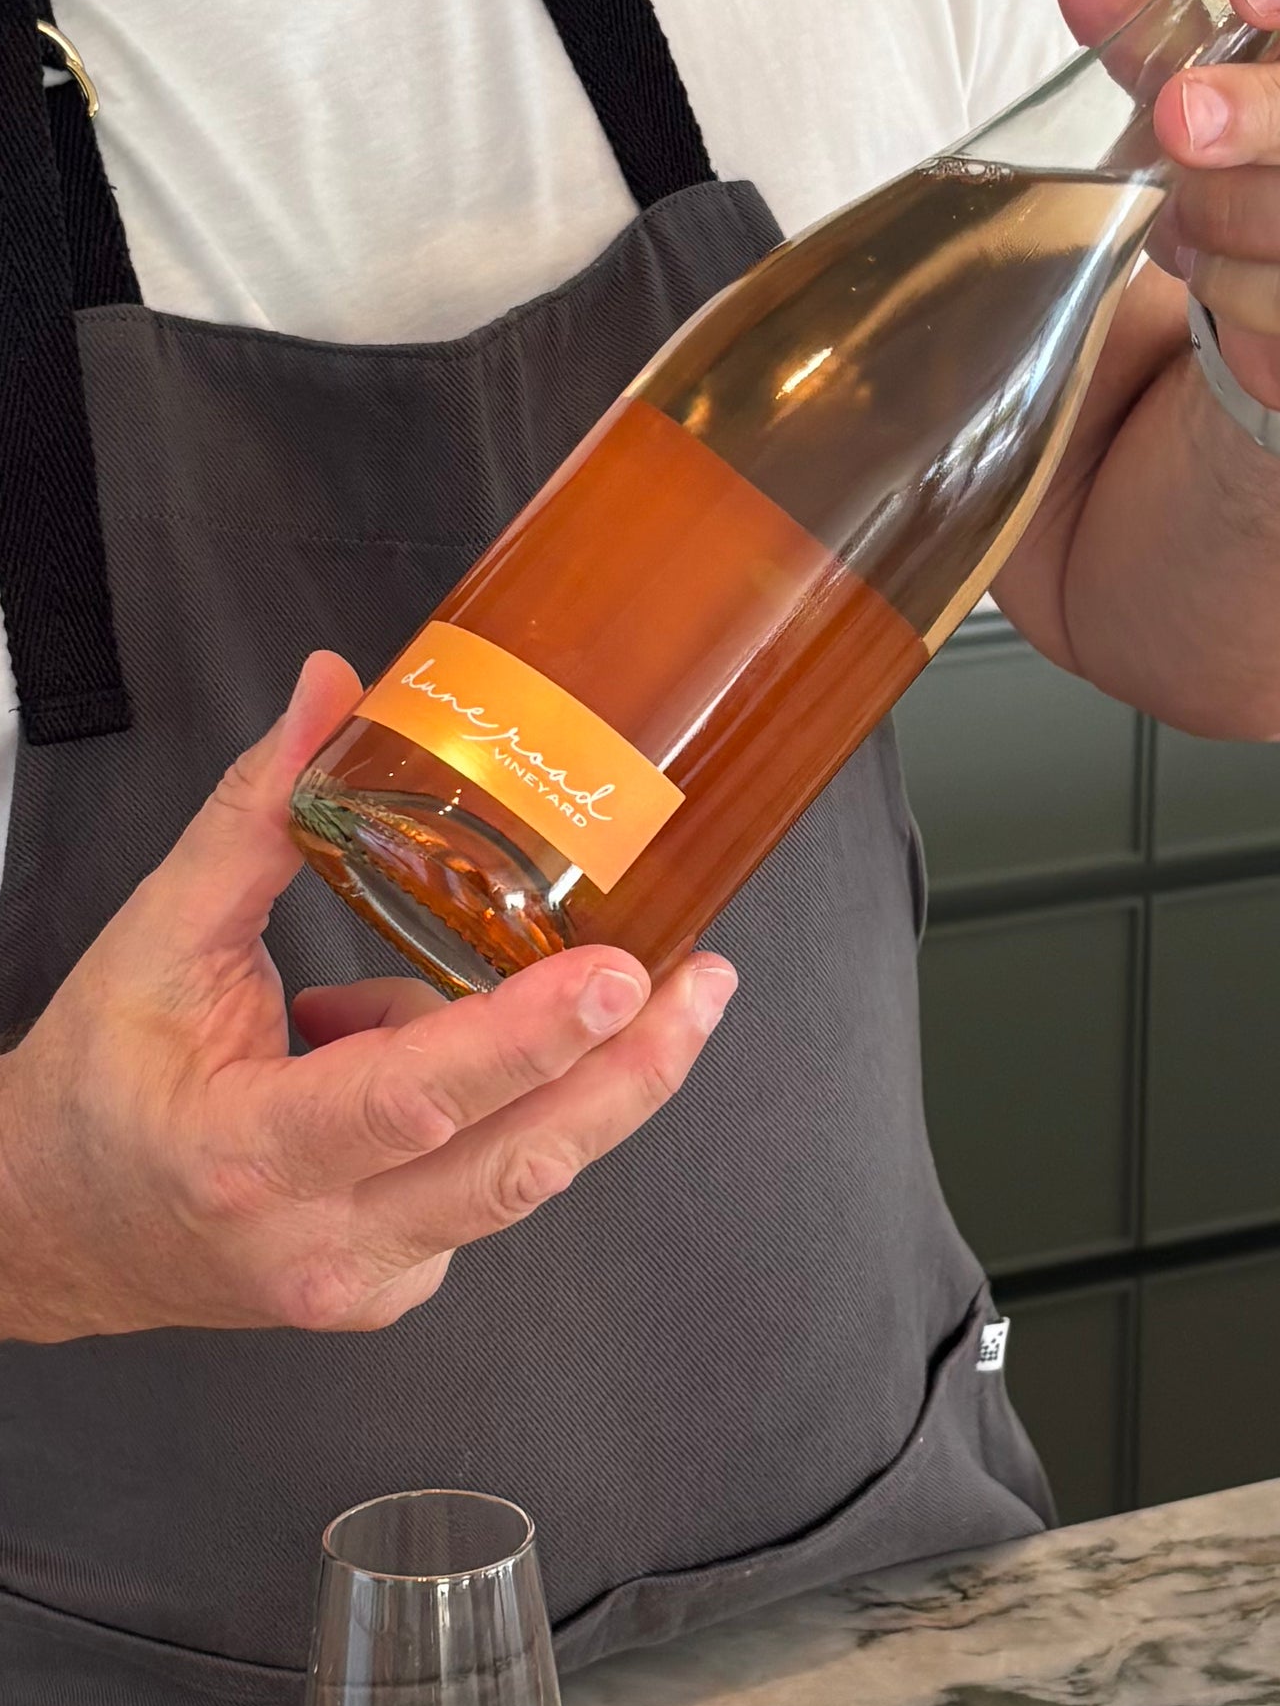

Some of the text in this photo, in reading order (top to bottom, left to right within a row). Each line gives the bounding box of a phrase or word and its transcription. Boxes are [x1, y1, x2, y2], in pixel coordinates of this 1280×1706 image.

[401, 658, 616, 821] dune road
[494, 747, 588, 828] VINEYARD
